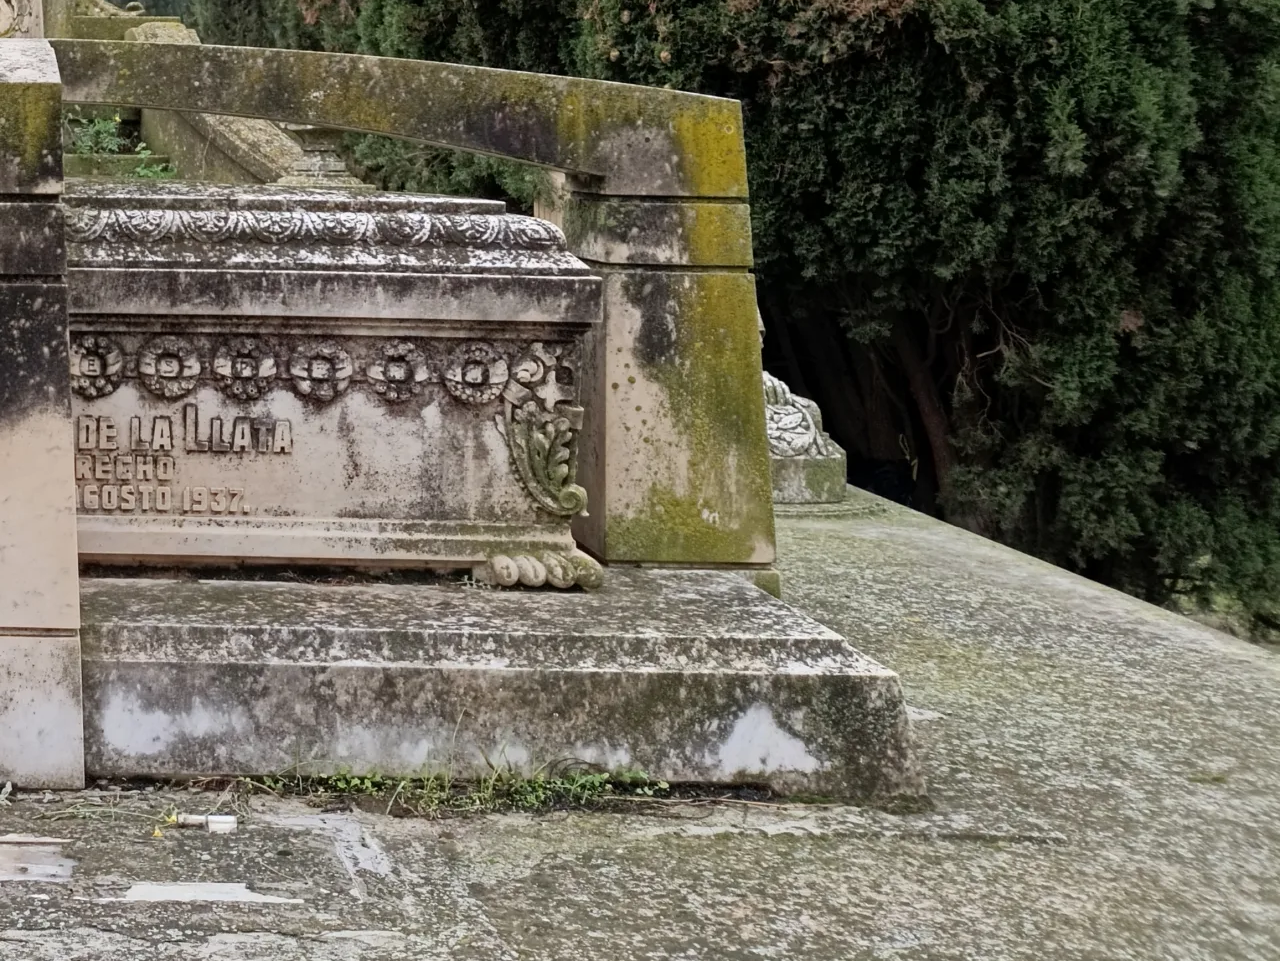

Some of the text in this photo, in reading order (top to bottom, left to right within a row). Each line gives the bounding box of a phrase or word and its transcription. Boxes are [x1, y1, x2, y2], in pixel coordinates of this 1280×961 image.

[78, 415, 117, 450] DE
[131, 415, 172, 451] LA
[185, 403, 294, 453] LLATA
[183, 487, 251, 513] 1937.
